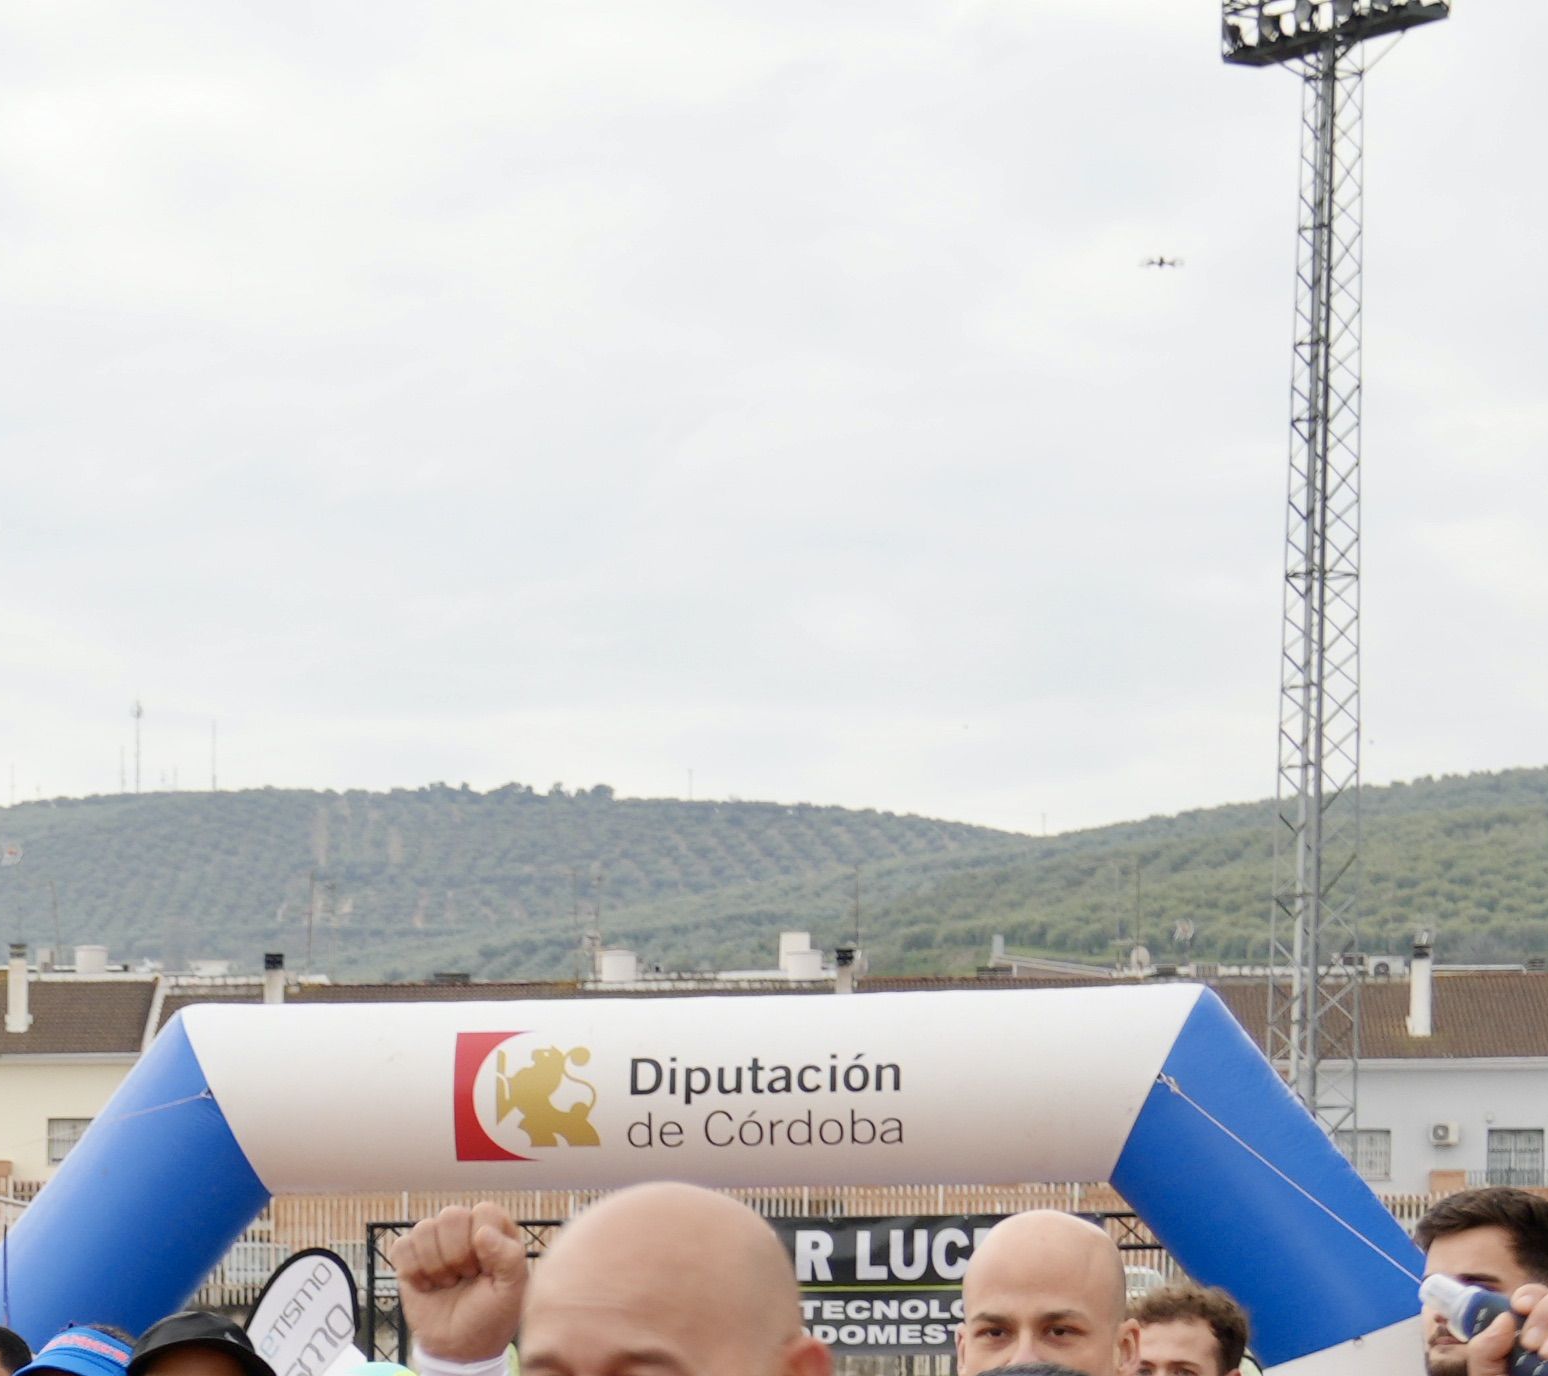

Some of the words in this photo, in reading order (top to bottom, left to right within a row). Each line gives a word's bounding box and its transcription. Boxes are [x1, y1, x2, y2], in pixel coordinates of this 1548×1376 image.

[630, 1053, 902, 1104] Diputación
[627, 1112, 684, 1148] de
[703, 1109, 904, 1148] Córdoba
[856, 1227, 995, 1281] LUC
